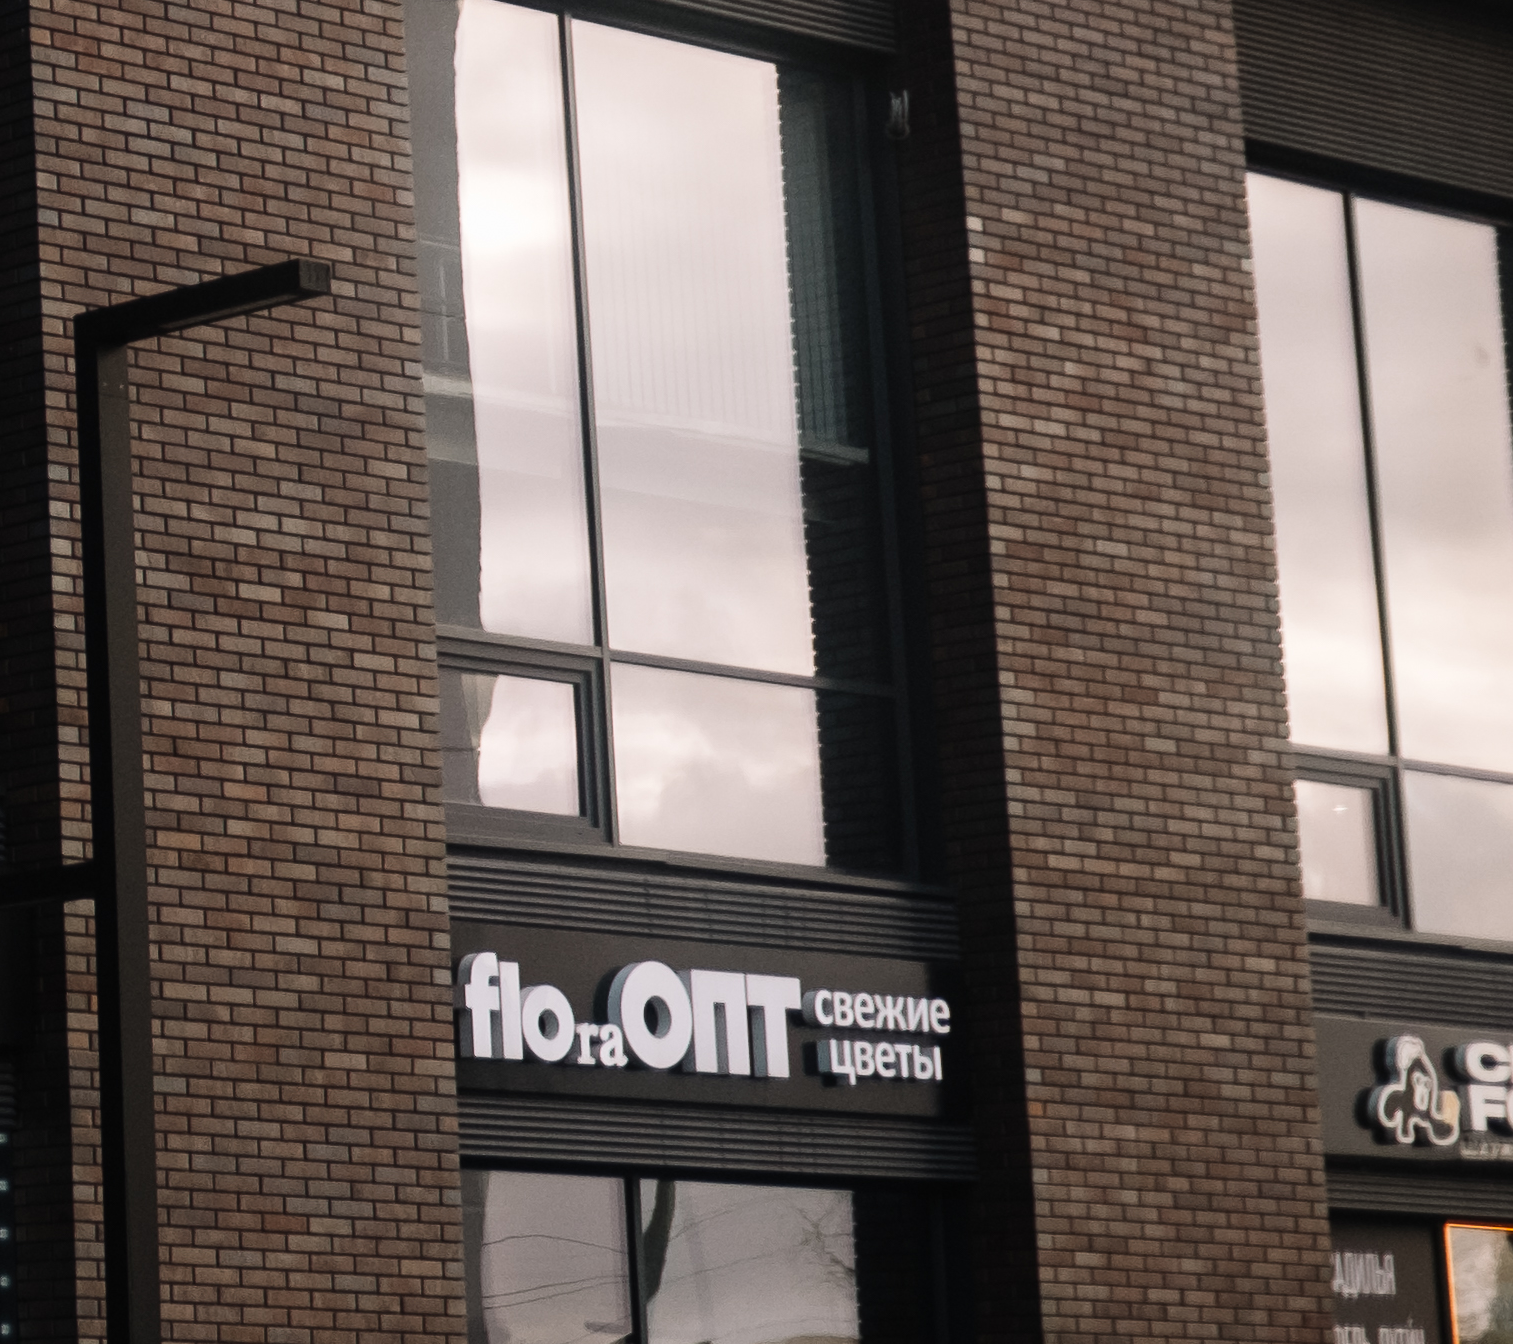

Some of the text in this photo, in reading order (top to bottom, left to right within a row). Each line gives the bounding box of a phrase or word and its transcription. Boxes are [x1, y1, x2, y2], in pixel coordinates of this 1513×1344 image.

[809, 989, 952, 1035] свежие
[824, 1037, 944, 1086] цветы
[1462, 1041, 1513, 1084] C
